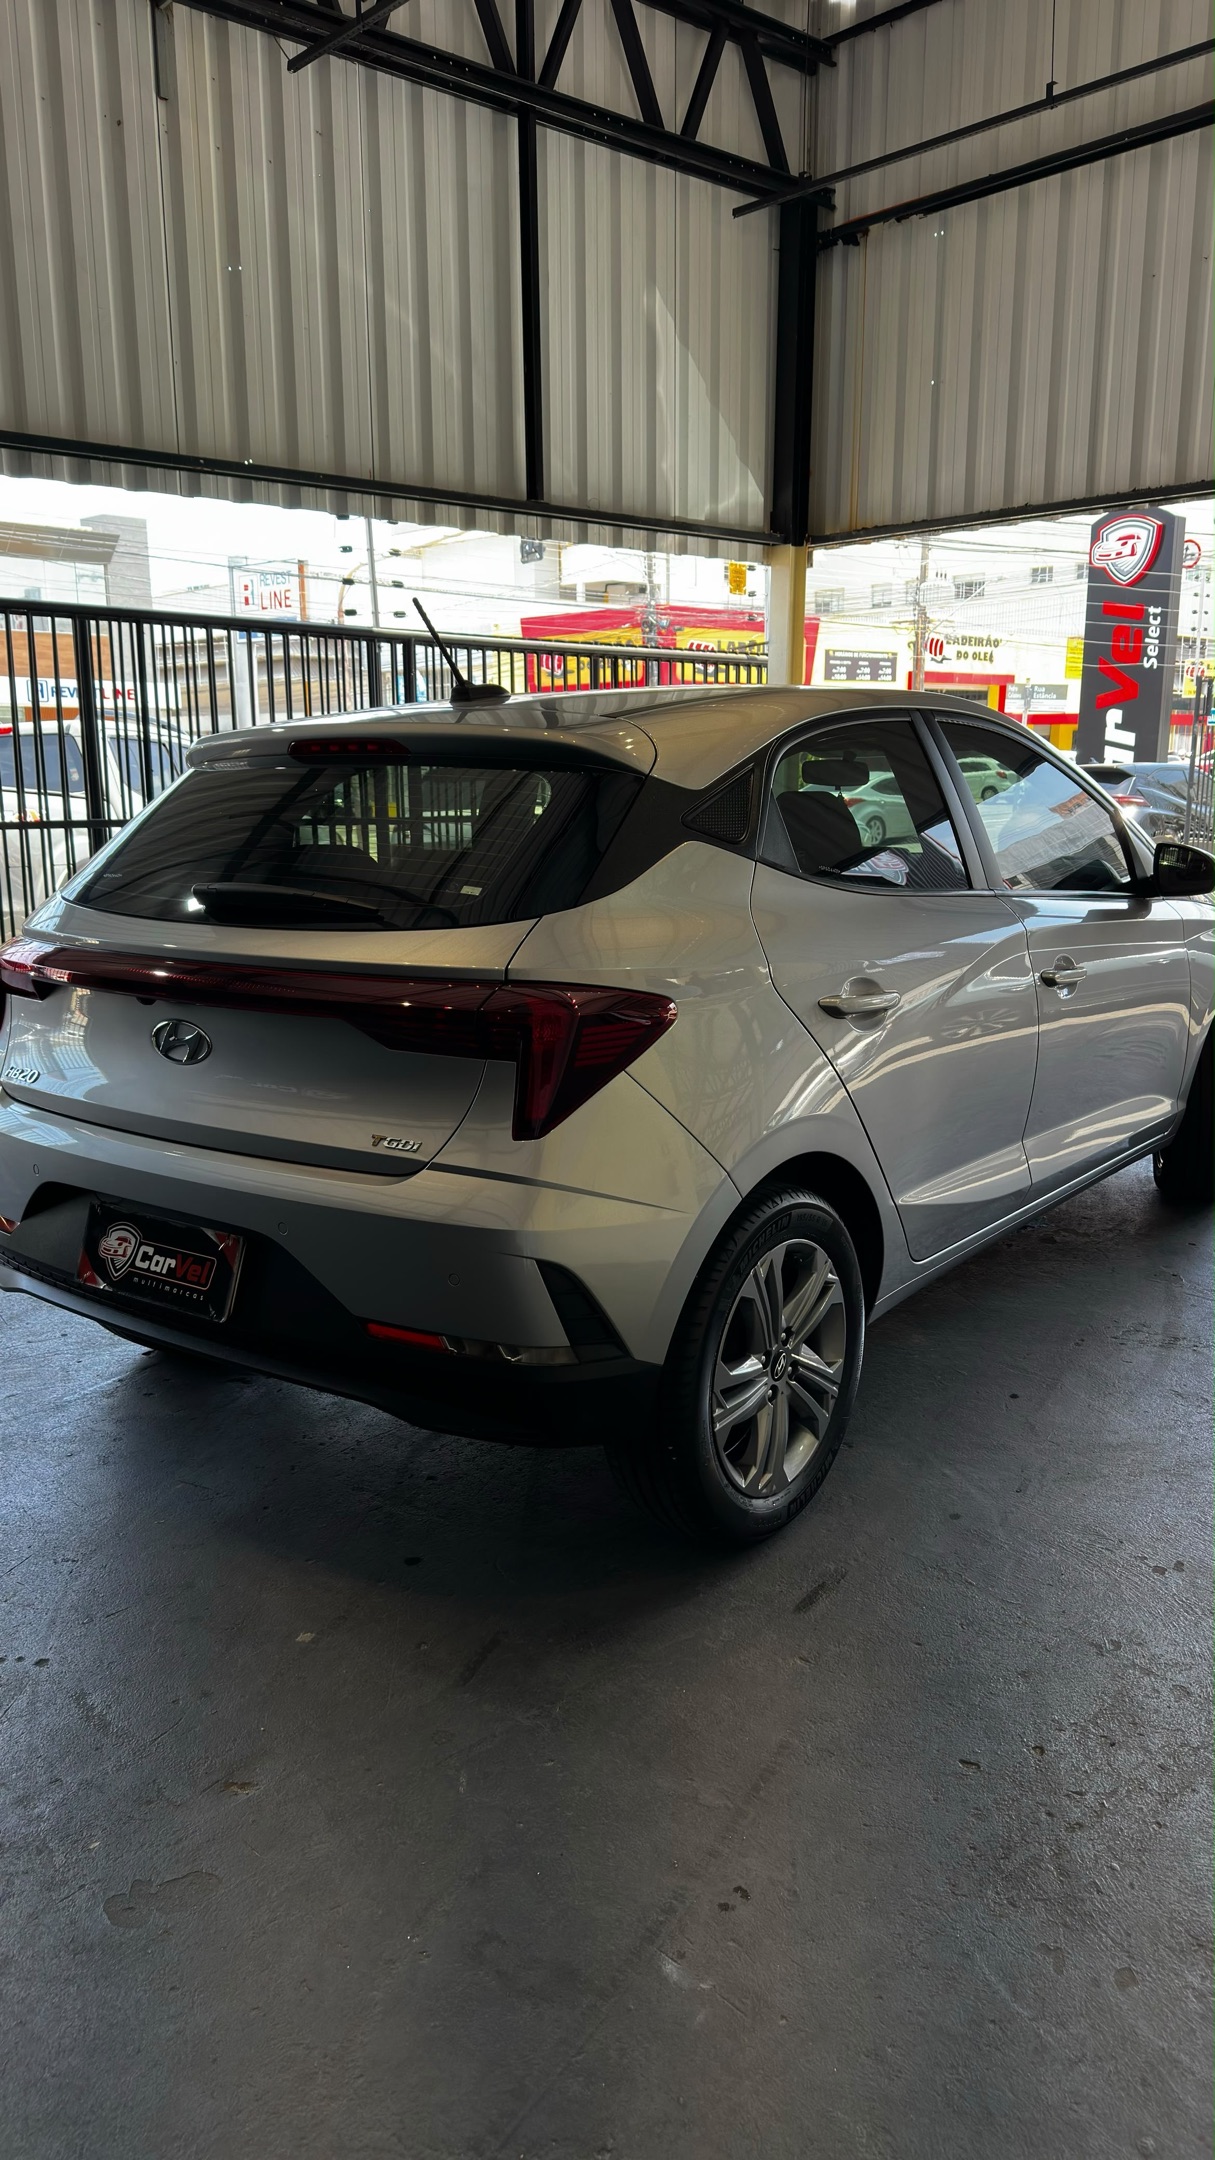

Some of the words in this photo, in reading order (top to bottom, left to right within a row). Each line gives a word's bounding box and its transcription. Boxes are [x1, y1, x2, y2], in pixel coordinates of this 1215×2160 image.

[260, 571, 292, 587] REVEST
[261, 589, 292, 610] LINE
[1143, 605, 1162, 669] Select
[956, 650, 969, 661] DO
[101, 687, 136, 700] LNE
[4, 1066, 41, 1084] HB20
[739, 1212, 792, 1276] MICHELIN
[134, 1244, 211, 1285] CarVel
[133, 1276, 205, 1301] multimarcas
